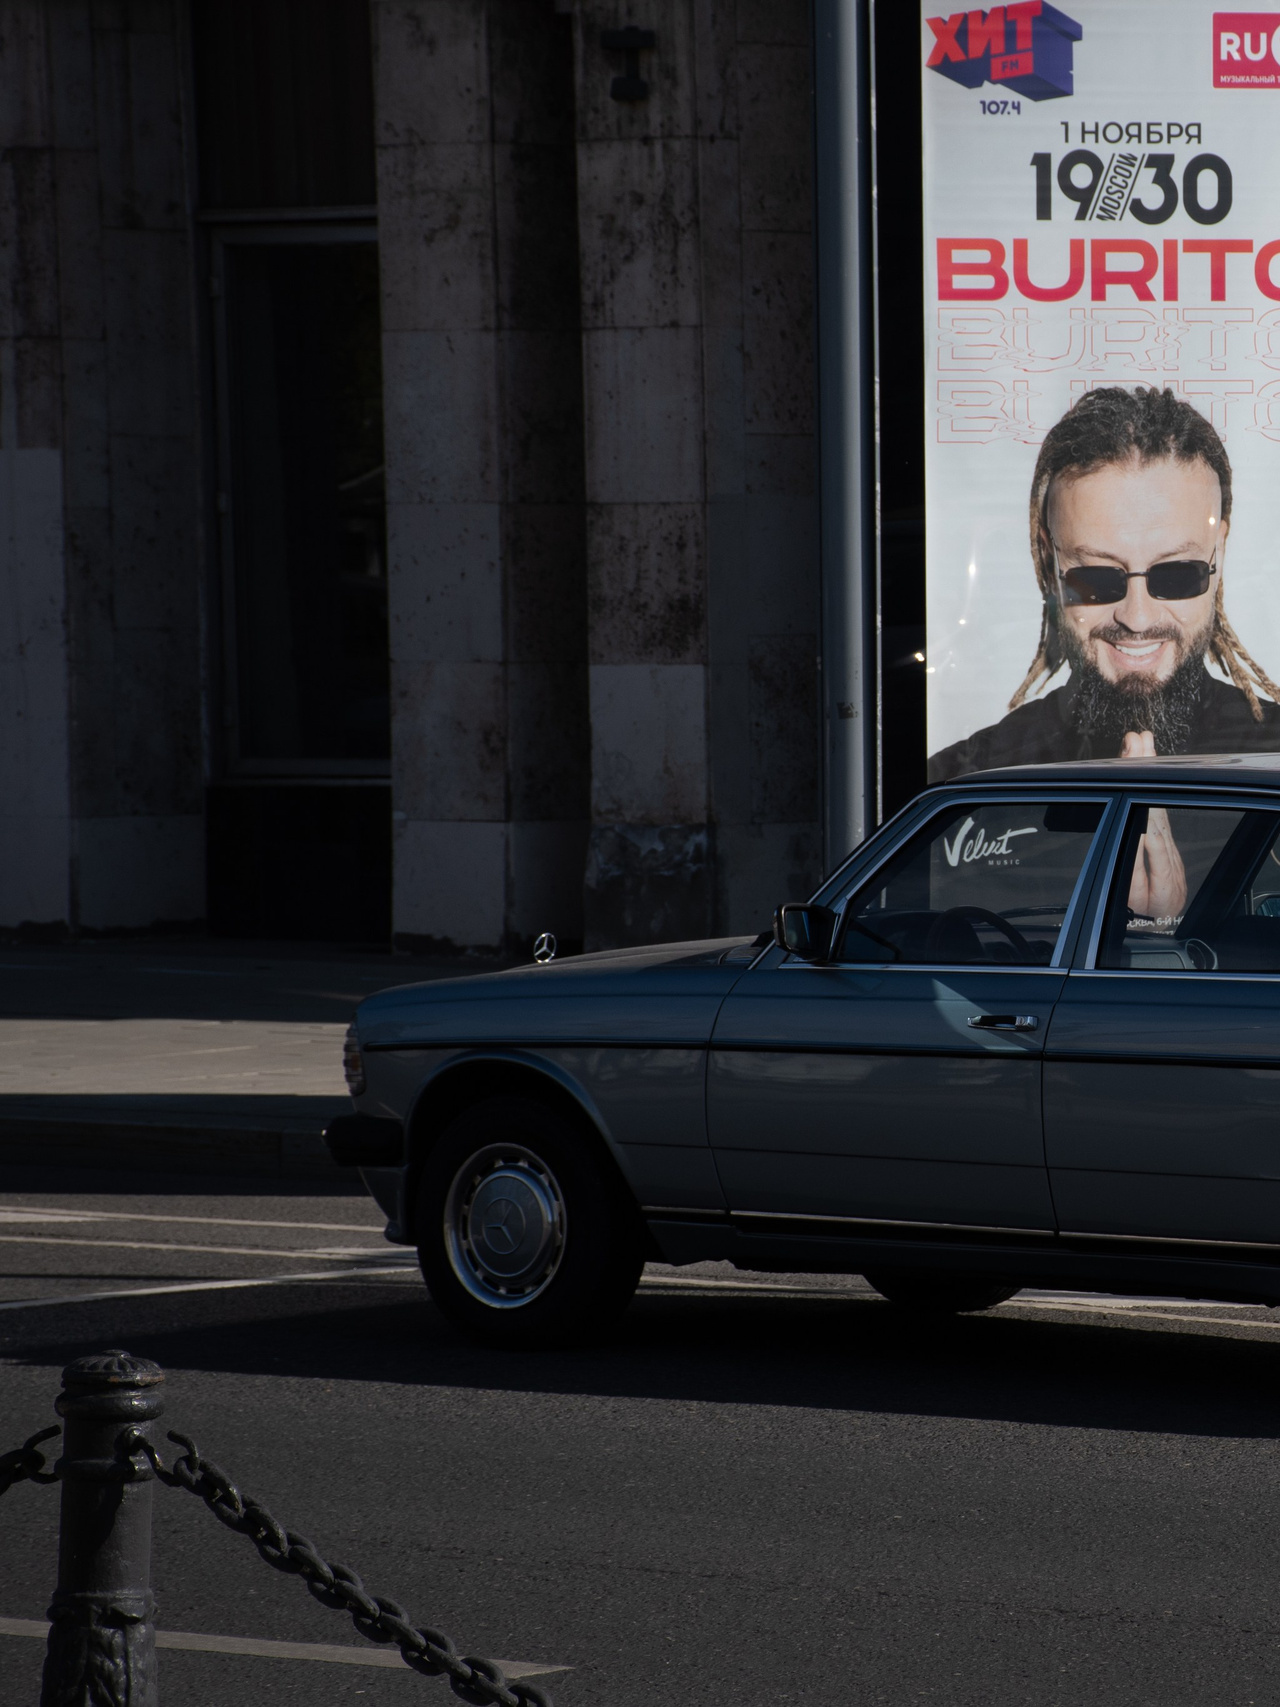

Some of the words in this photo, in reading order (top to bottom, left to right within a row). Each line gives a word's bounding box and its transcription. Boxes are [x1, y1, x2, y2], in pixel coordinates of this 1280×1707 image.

[925, 0, 1043, 67] ХИТ
[1219, 31, 1268, 62] RU
[1001, 59, 1019, 73] FM
[1220, 74, 1276, 83] МУЗЫКАЛЬНЫЙ
[979, 100, 1021, 115] 107.4
[1060, 121, 1070, 144] 1
[1081, 121, 1202, 145] НОЯБРЯ
[1097, 153, 1138, 222] MOSCOW
[943, 816, 1039, 867] Velvet
[987, 858, 1021, 866] MUSIC
